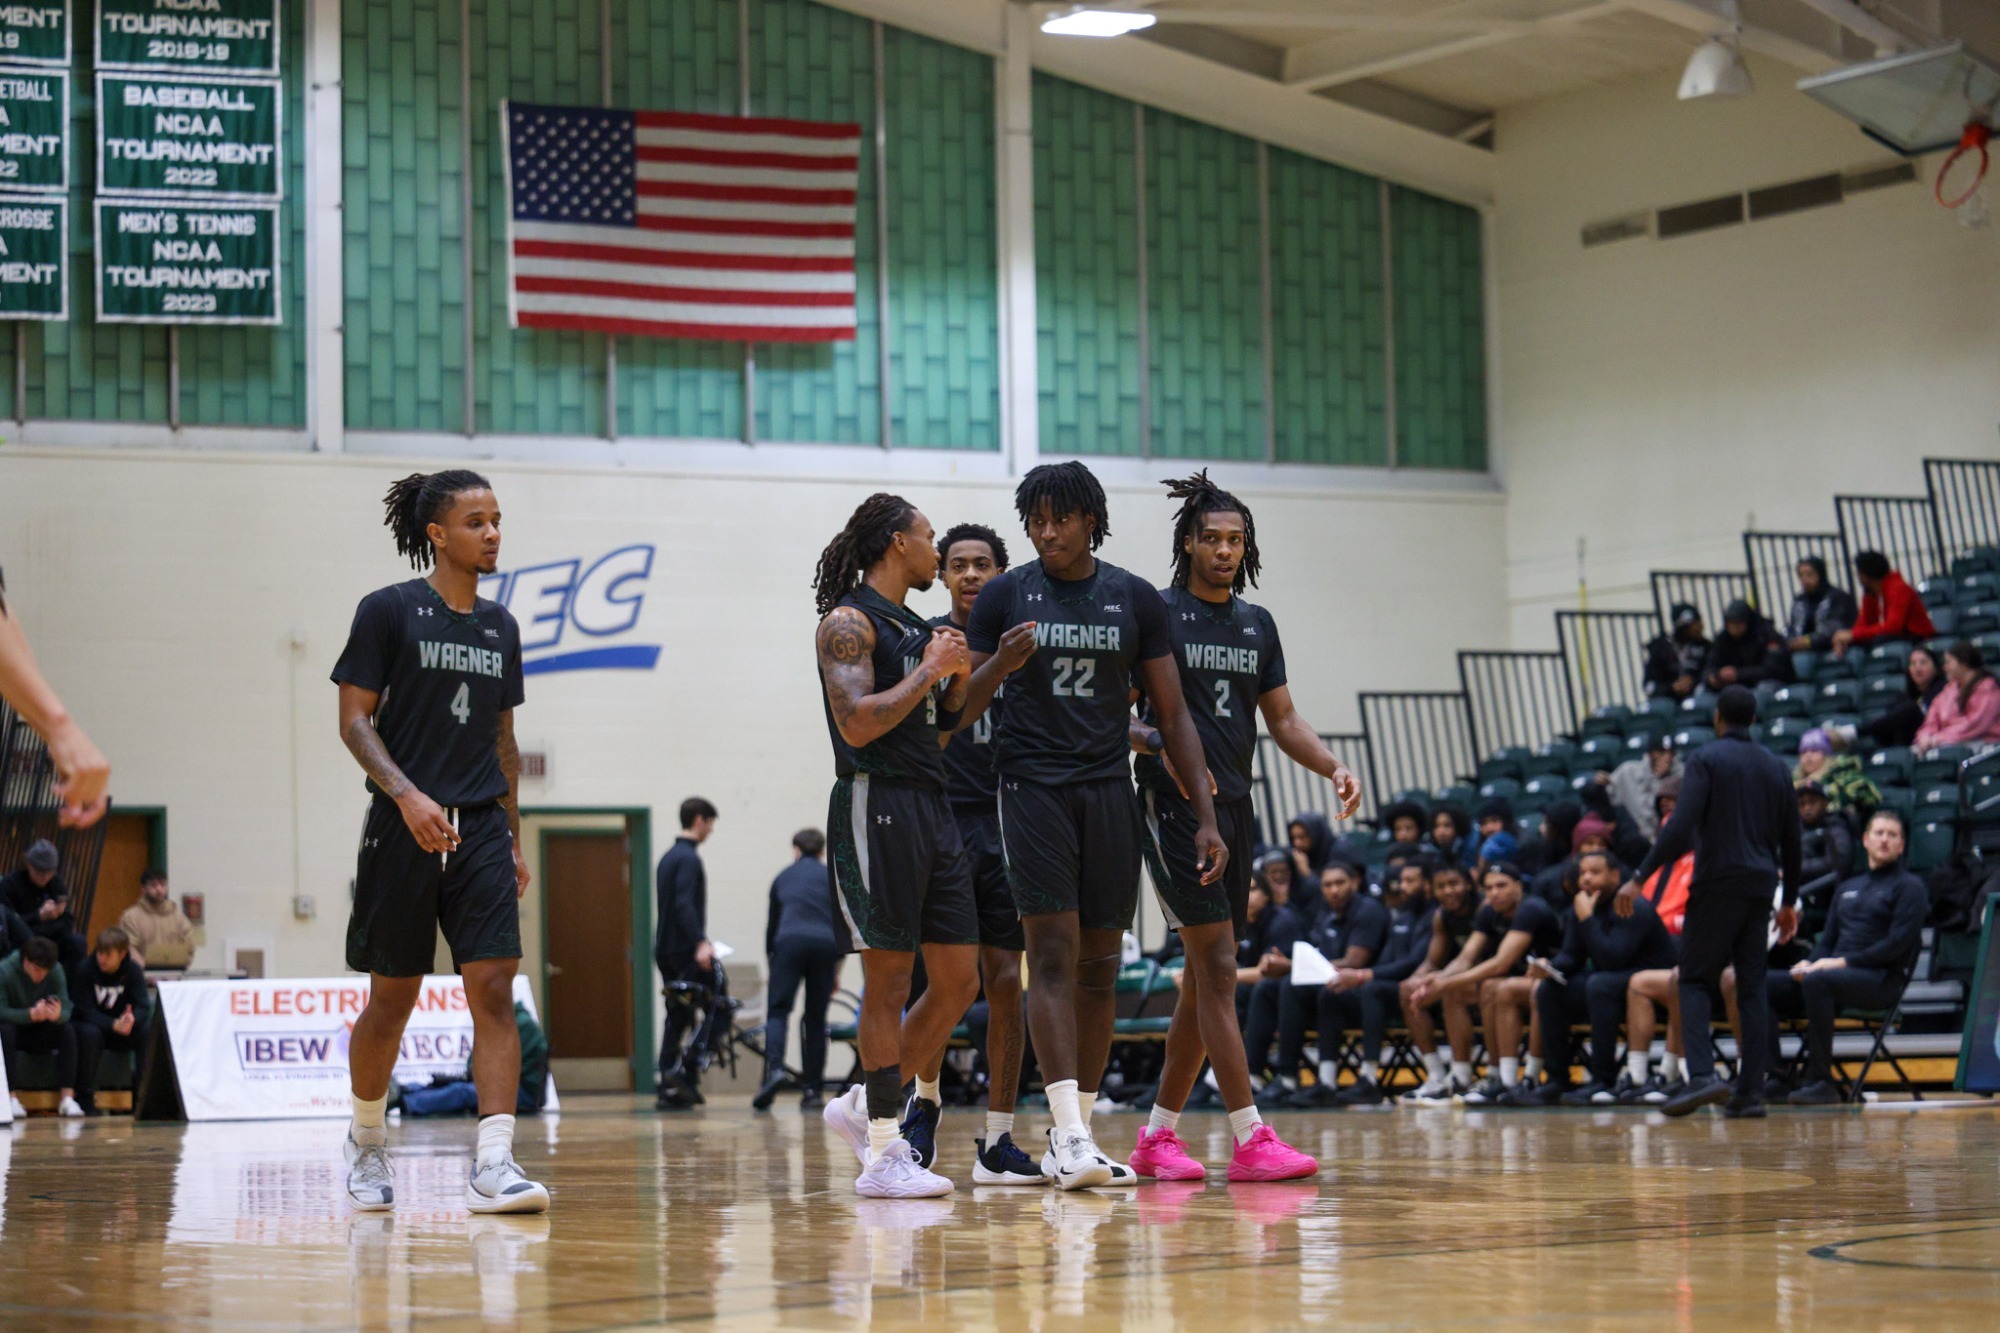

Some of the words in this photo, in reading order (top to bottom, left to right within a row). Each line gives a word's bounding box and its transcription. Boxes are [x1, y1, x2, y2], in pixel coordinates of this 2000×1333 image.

[104, 12, 271, 39] TOURNAMENT
[123, 85, 255, 111] BASEBALL
[155, 112, 224, 136] NCAA
[106, 138, 273, 165] TOURNAMENT
[163, 167, 218, 186] 2022
[118, 210, 179, 234] MEN'S
[184, 213, 256, 235] TENNIS
[153, 239, 223, 262] NCAA
[106, 265, 271, 289] TOURNAMENT
[162, 293, 217, 312] 2023
[1032, 622, 1120, 651] WAGNER
[419, 640, 502, 678] WAGNER
[1184, 643, 1258, 675] WAGNER
[1052, 657, 1095, 697] 22
[450, 682, 470, 724] 4
[1214, 679, 1231, 717] 2
[245, 1038, 330, 1062] IBEW
